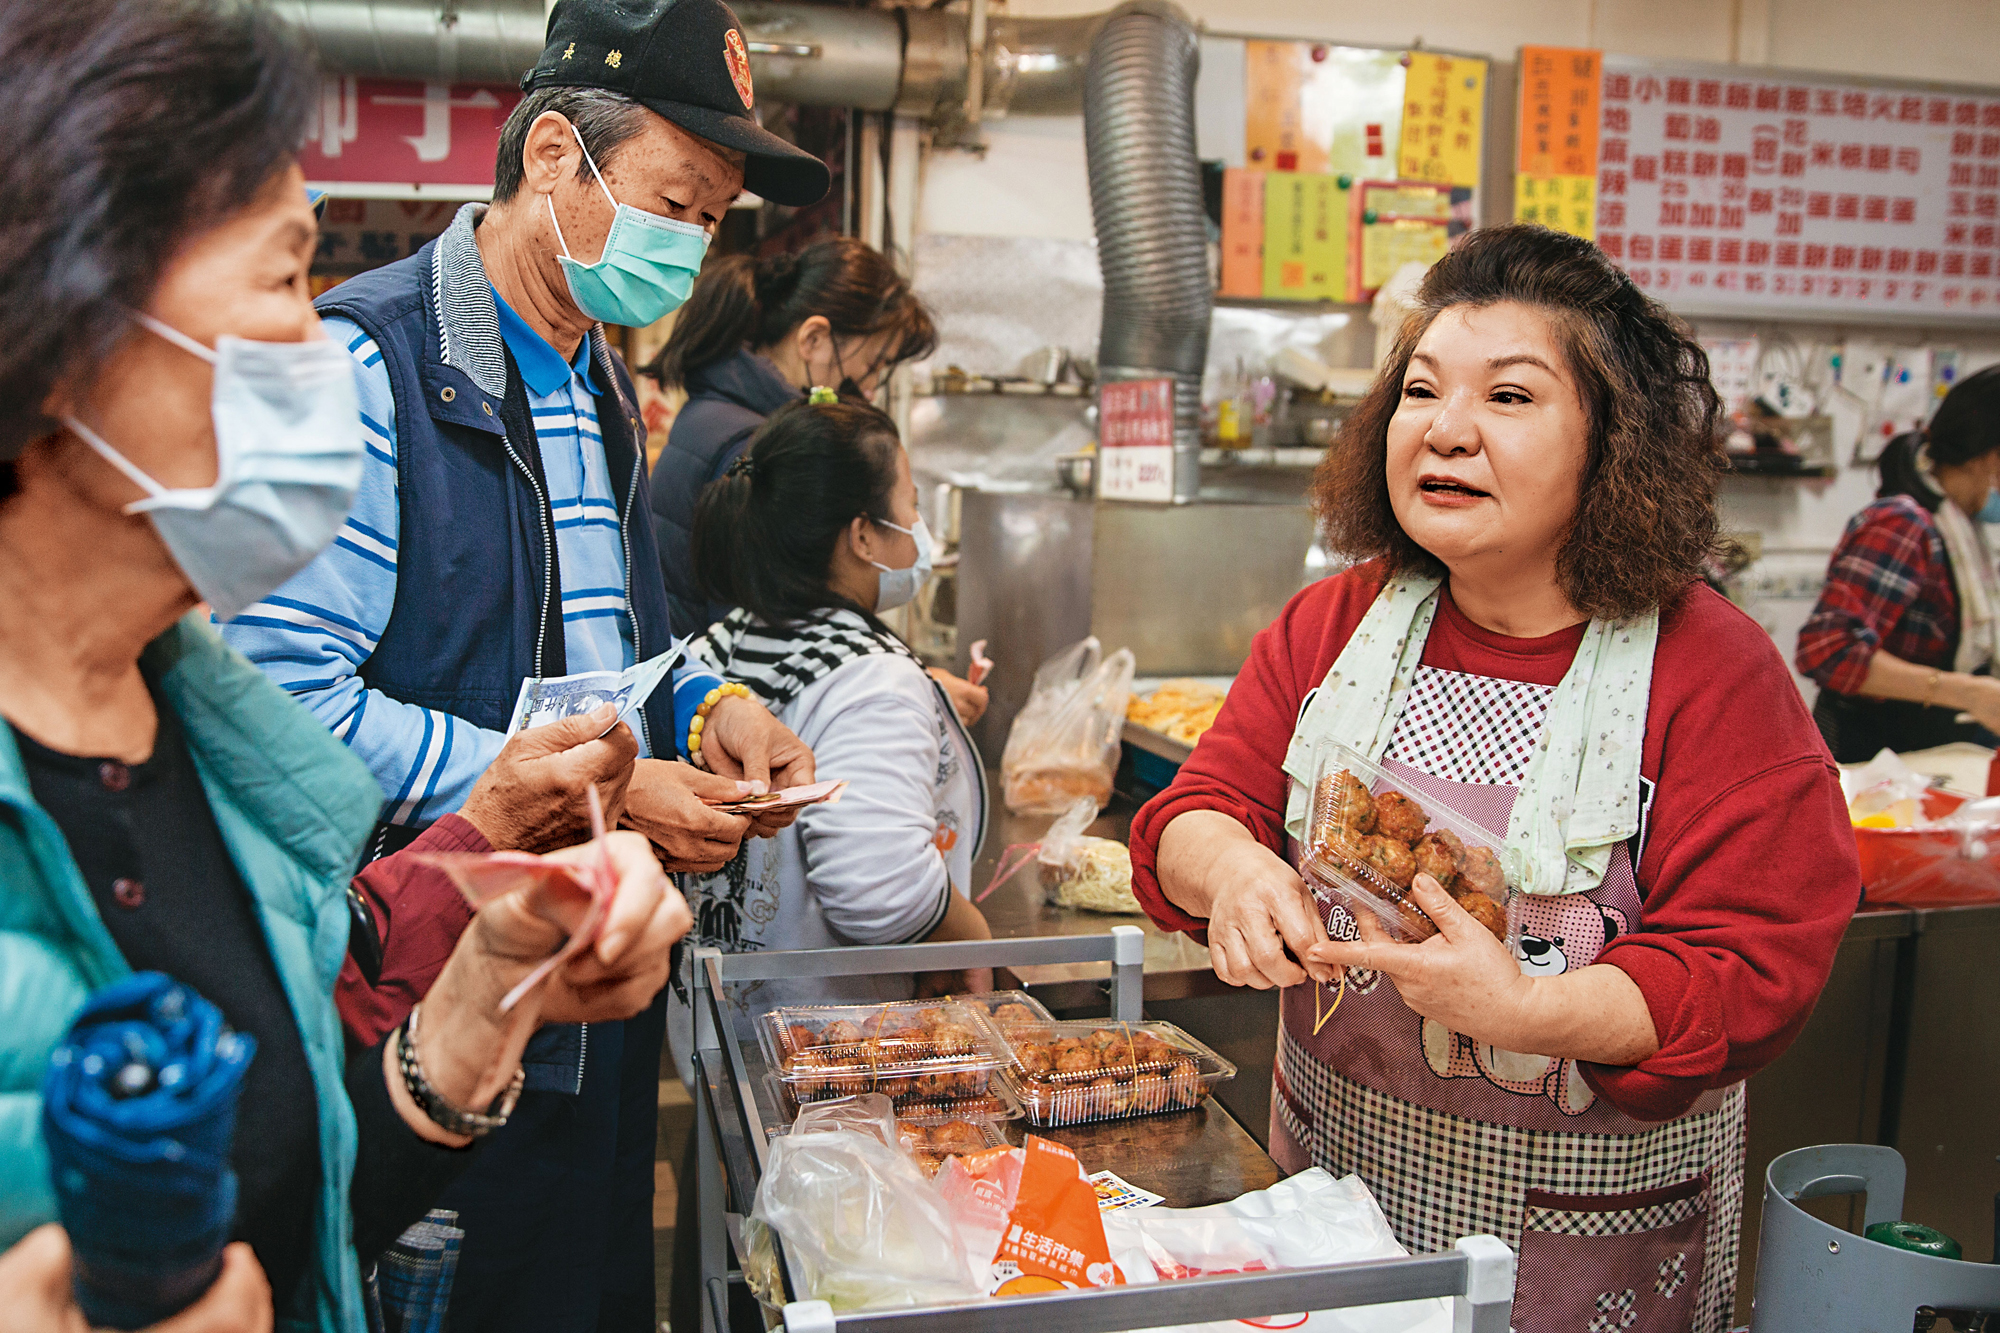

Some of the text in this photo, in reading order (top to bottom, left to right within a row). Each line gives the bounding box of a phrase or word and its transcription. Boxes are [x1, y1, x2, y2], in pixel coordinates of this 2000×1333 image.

[1803, 89, 1838, 270] 玉米蛋餅
[1830, 92, 1867, 271] 培根蛋餅
[1858, 96, 1896, 273] 火腿蛋餅
[1887, 97, 1923, 274] 起司蛋餅
[1020, 1229, 1086, 1269] 生活市集
